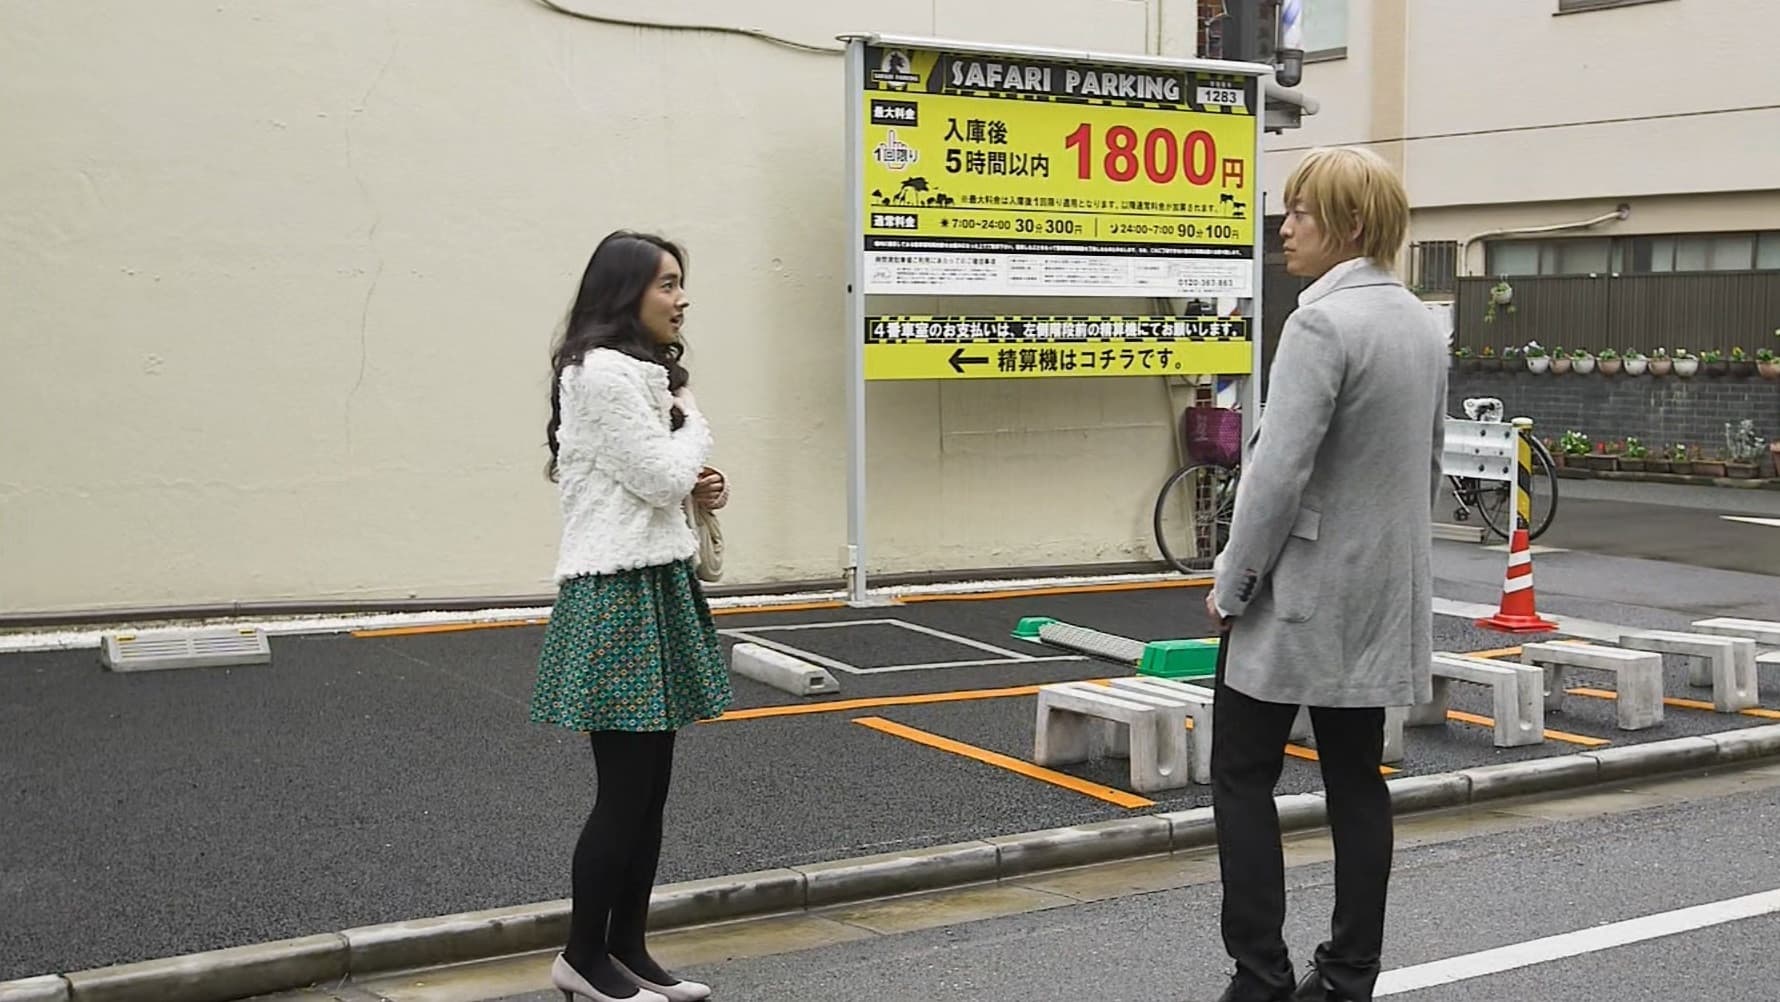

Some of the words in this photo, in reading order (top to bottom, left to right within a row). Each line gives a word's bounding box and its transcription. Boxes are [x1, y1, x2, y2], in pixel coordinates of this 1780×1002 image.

[952, 60, 1052, 92] SAFARI
[1065, 69, 1180, 101] PARKING
[1204, 90, 1237, 104] 1283
[873, 105, 916, 120] 最大料金
[944, 117, 1009, 145] 入庫後
[873, 147, 918, 163] 1回限り
[945, 148, 1050, 178] 5時間以内
[998, 347, 1183, 372] 精算機はコチラです。
